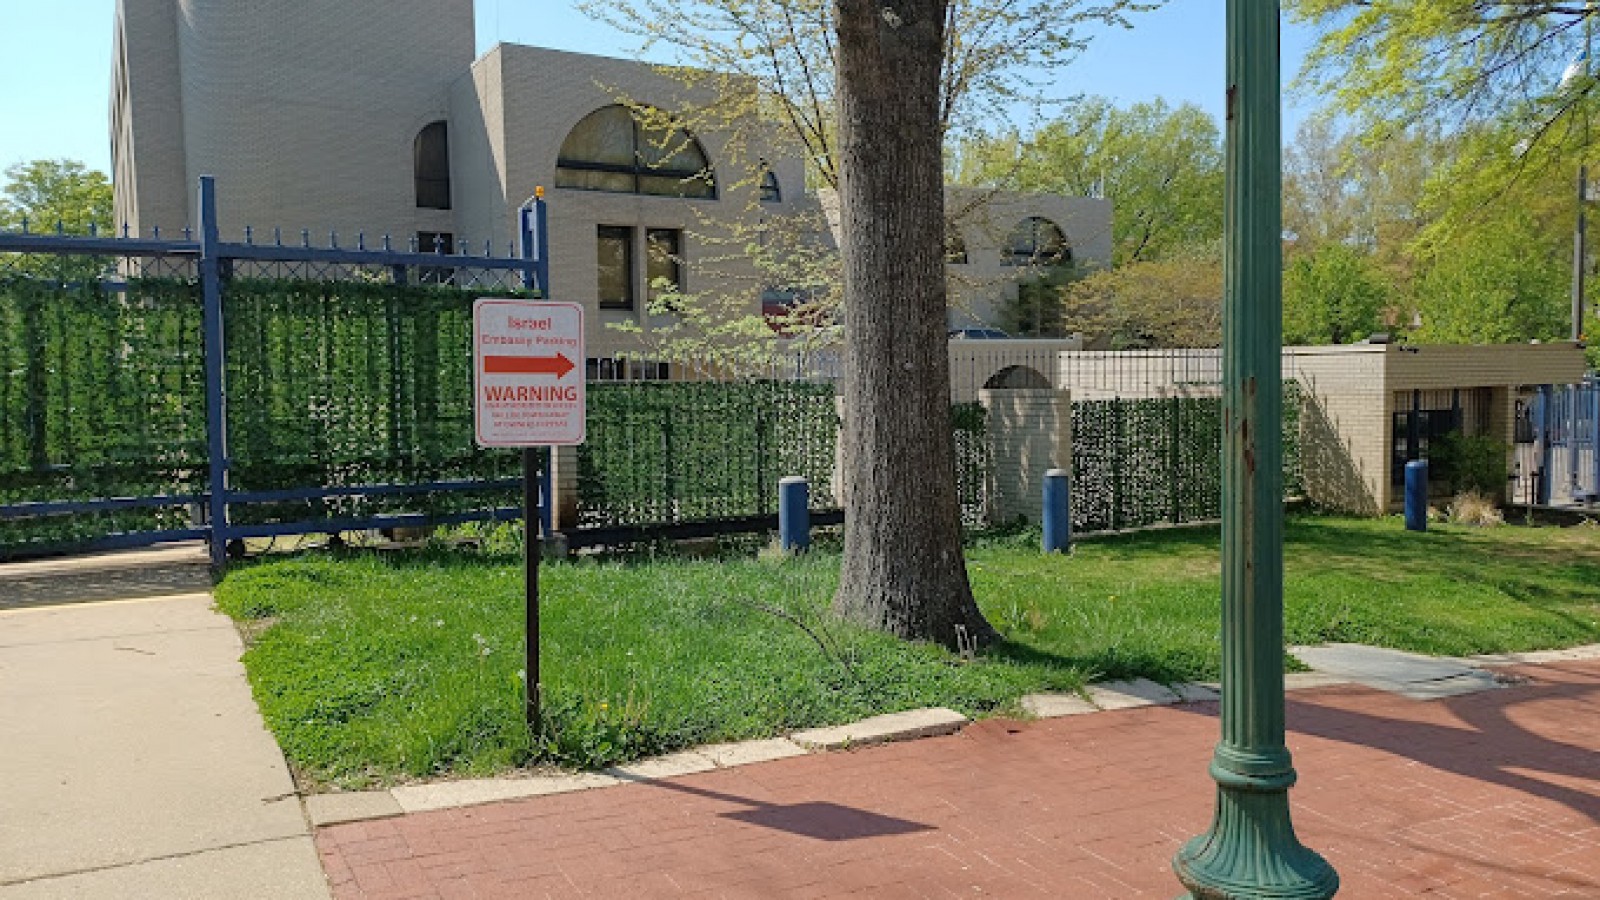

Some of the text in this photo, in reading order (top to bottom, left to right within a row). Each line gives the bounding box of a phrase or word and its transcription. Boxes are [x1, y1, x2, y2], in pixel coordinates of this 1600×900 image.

[508, 316, 551, 330] Israel
[481, 334, 577, 349] Embassy Parking
[484, 386, 577, 401] WARNING
